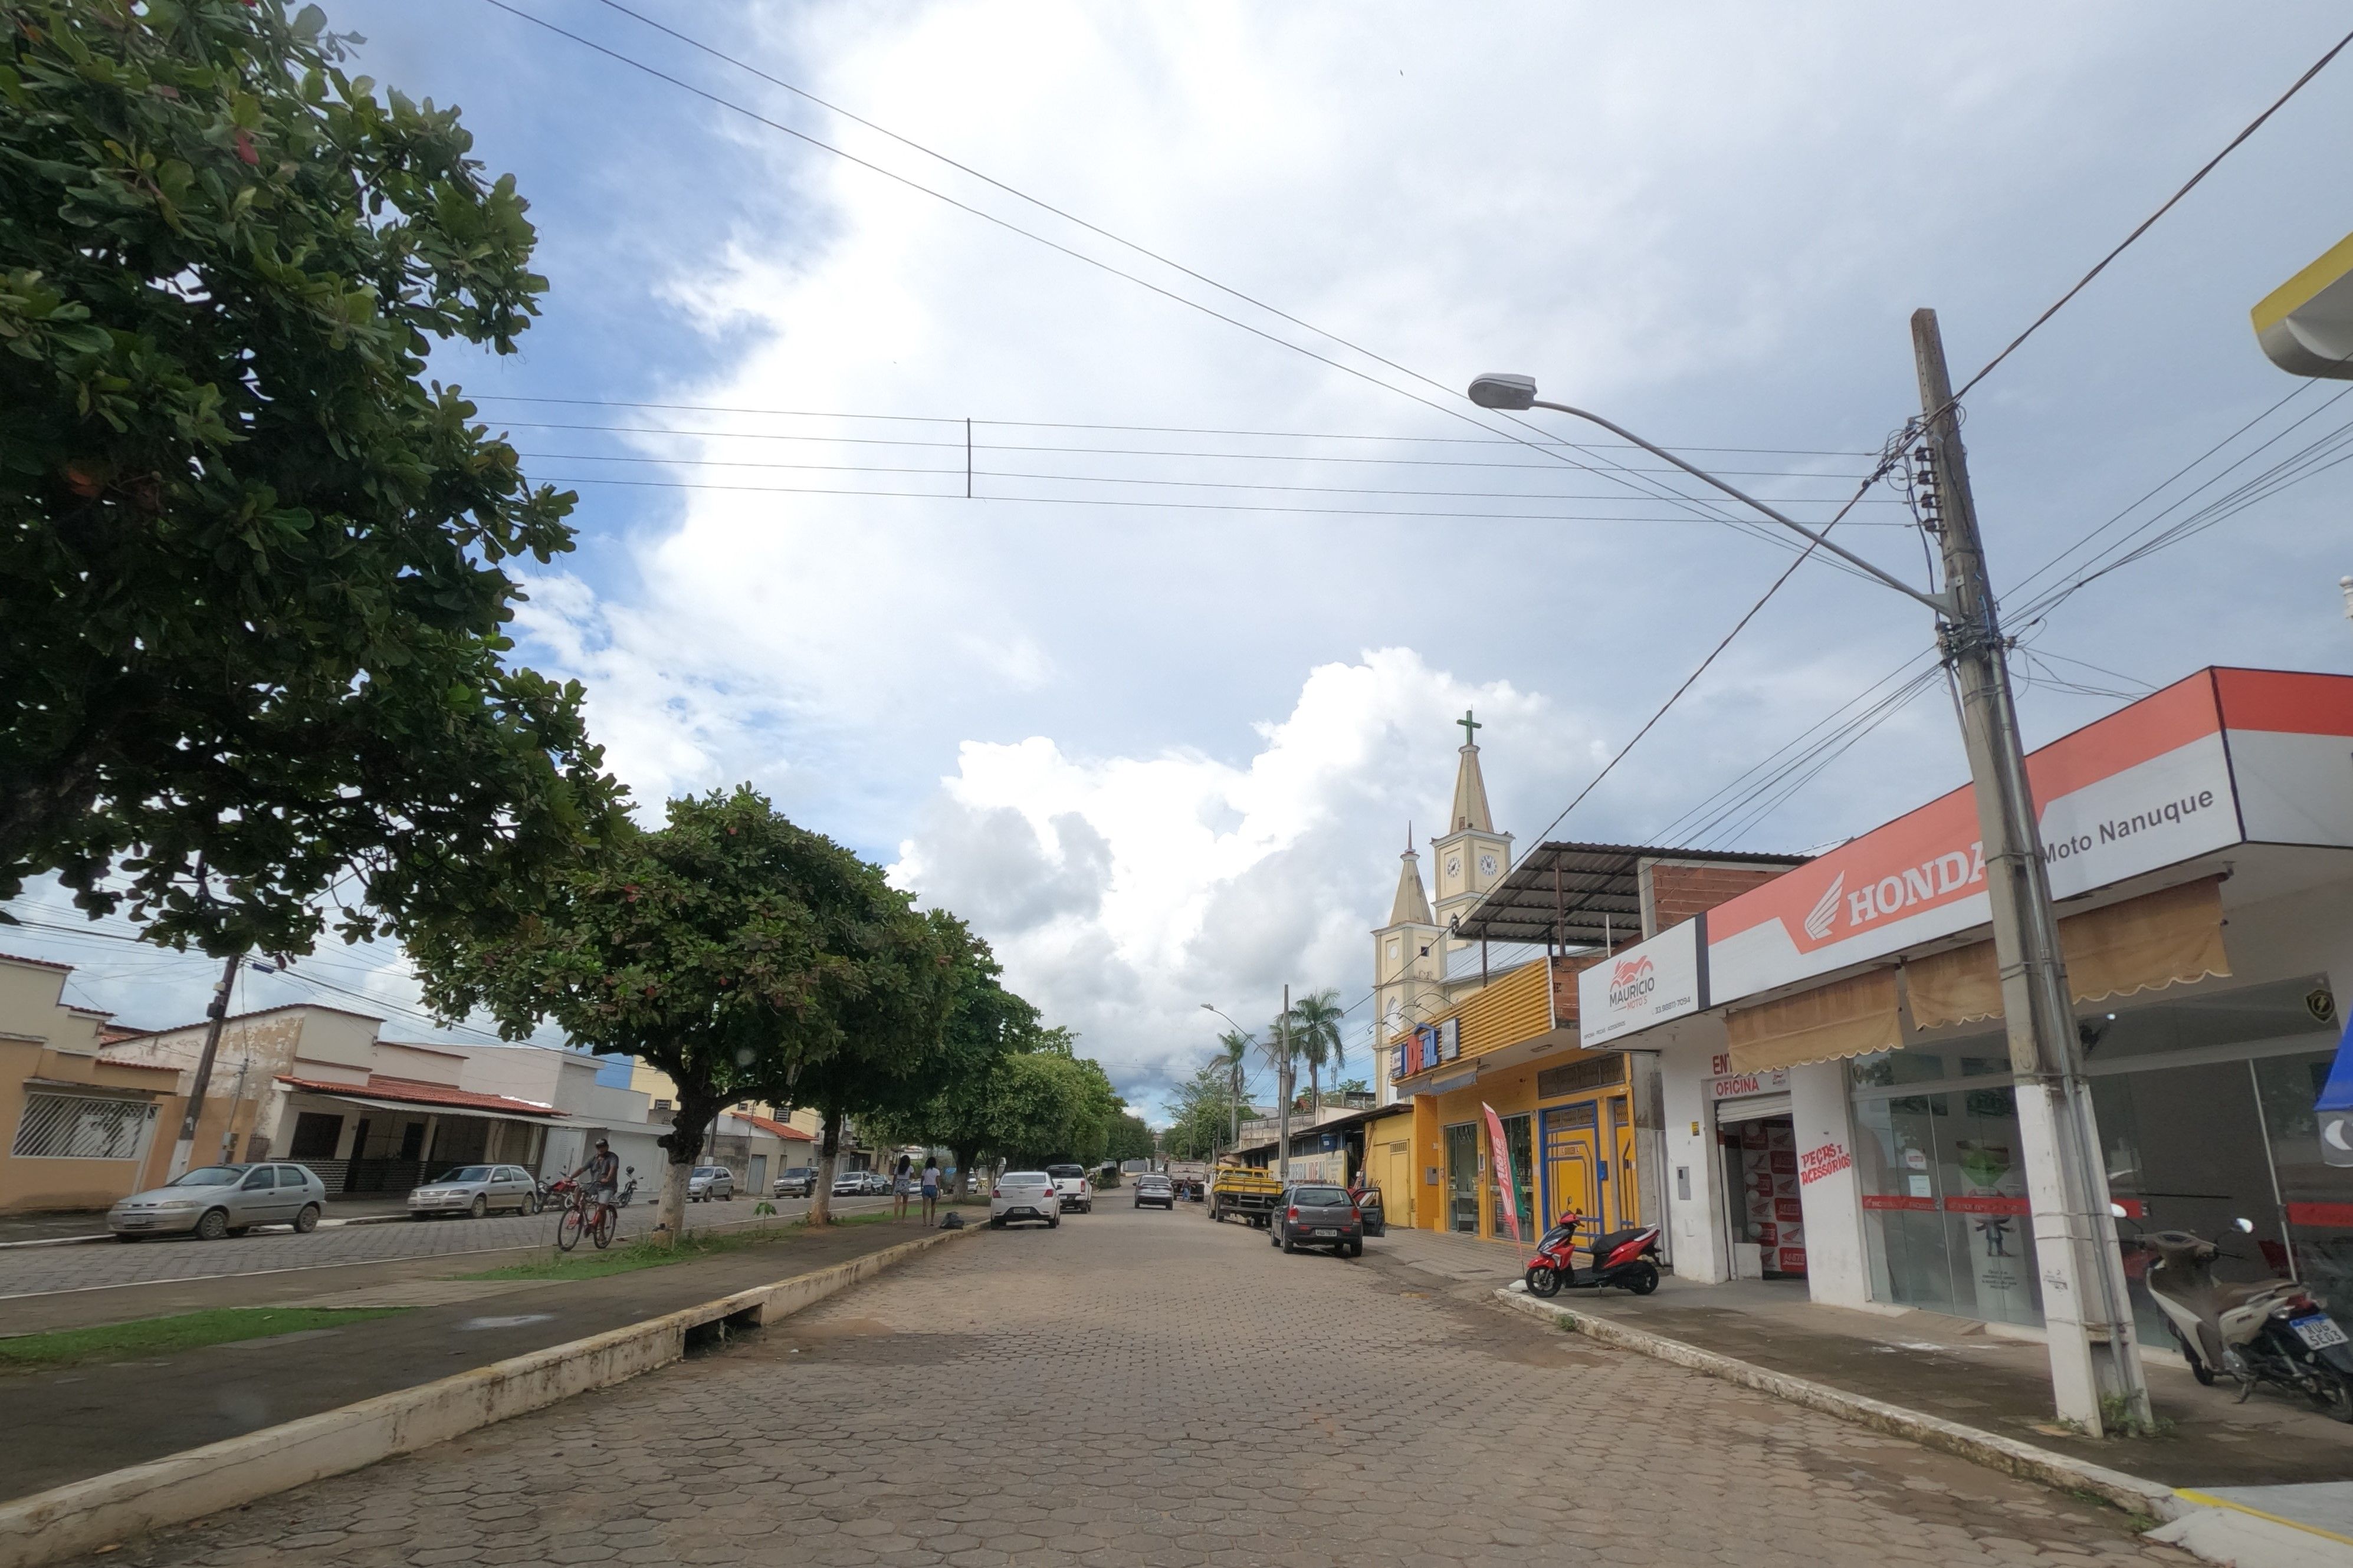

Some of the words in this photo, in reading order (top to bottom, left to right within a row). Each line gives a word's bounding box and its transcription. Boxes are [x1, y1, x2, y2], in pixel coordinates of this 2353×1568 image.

[2042, 835, 2092, 863] Moto
[2099, 790, 2214, 844] Nanuque
[1610, 977, 1655, 1007] MAURÍCIO
[1404, 1030, 1438, 1076] IDEAL
[1716, 1077, 1760, 1096] OFICINA
